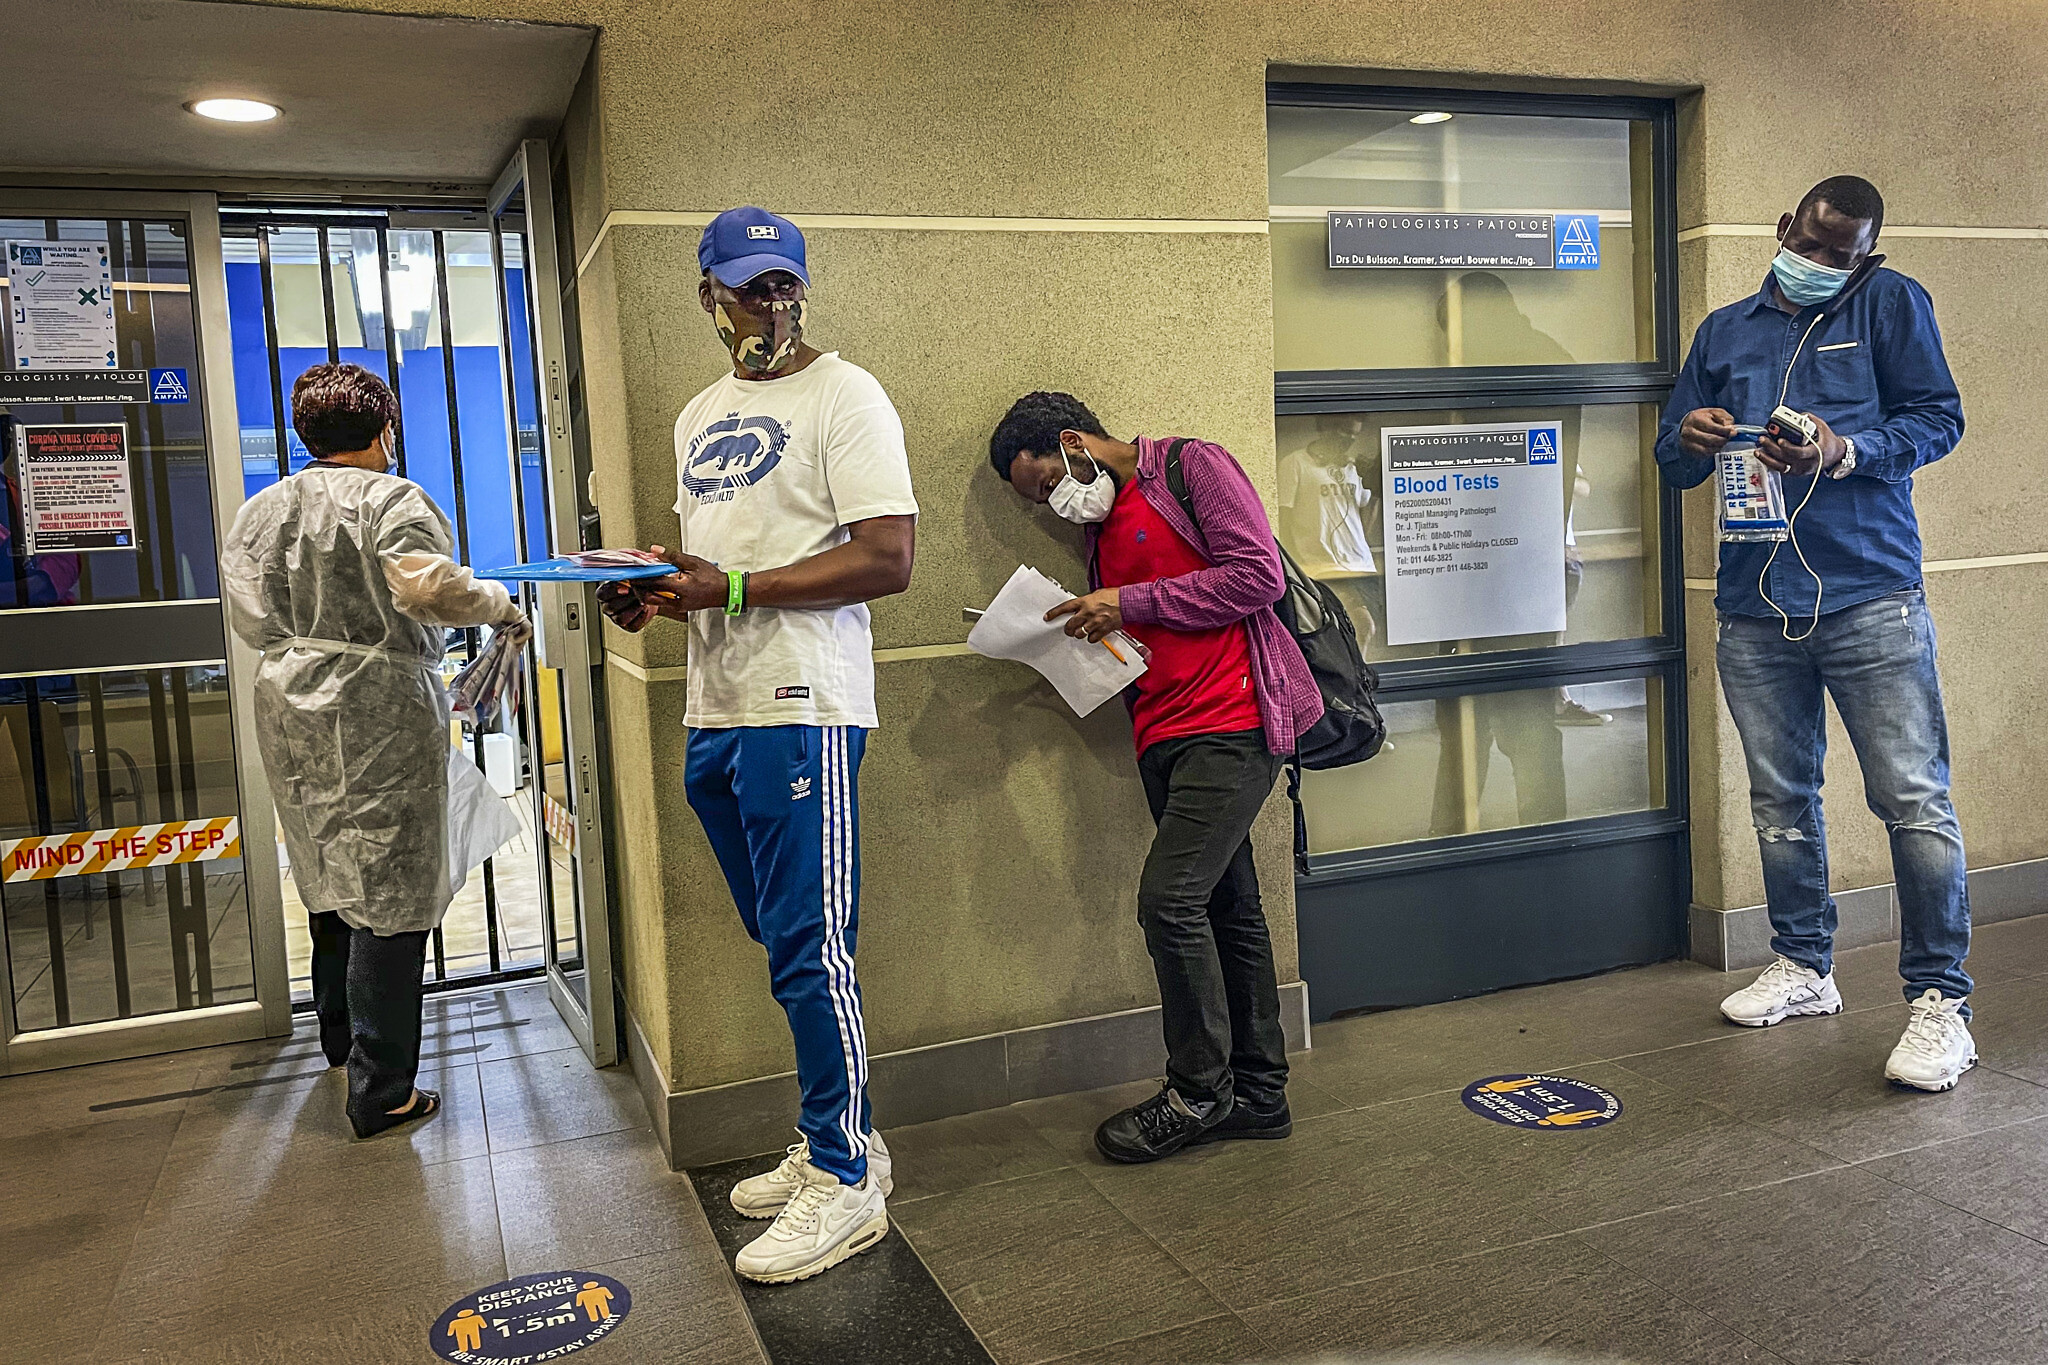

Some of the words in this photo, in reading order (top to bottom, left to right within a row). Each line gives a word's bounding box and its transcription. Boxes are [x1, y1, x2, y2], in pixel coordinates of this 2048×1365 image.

[1334, 217, 1459, 230] PATHOLOGISTS
[1336, 254, 1350, 265] Drs
[1352, 254, 1364, 265] Du
[1366, 254, 1401, 266] Buisson,
[1403, 254, 1438, 266] Kramer,
[1467, 255, 1499, 265] Bouwer
[1558, 255, 1598, 265] AMPATH
[154, 393, 188, 401] AMPATH
[28, 434, 58, 444] CORONA
[60, 433, 81, 444] VIRUS
[1393, 436, 1469, 446] PATHOLOGISTS
[1531, 454, 1556, 462] AMPATH
[1394, 474, 1447, 495] Blood
[1453, 473, 1500, 491] Tests
[1724, 454, 1737, 508] ROUTINE
[1734, 455, 1748, 508] ROETINE
[61, 512, 91, 520] NECESSARY
[92, 511, 99, 519] TO
[100, 511, 123, 519] PREVENT
[1395, 510, 1424, 521] Regional
[1426, 508, 1458, 518] Managing
[1460, 506, 1496, 516] Pathologist
[38, 522, 64, 530] POSSIBLE
[65, 521, 91, 529] TRANSFER
[100, 520, 111, 528] THE
[1396, 534, 1411, 543] Mon
[1396, 544, 1431, 554] Weekends
[1439, 541, 1460, 551] Public
[1461, 539, 1489, 550] Holidays
[1491, 537, 1519, 547] CLOSED
[1397, 556, 1408, 565] Tel:
[1410, 555, 1421, 564] 011
[1397, 565, 1434, 577] Emergency
[1446, 564, 1458, 573] 011
[791, 789, 811, 801] adidas
[15, 844, 84, 871] MIND
[93, 836, 147, 861] THE
[156, 828, 229, 855] STEP.
[1471, 1094, 1501, 1111] YOUR
[1530, 1087, 1575, 1110] 1.5m
[1483, 1092, 1540, 1121] DISTANCE
[1496, 1109, 1525, 1123] KEEP
[477, 1288, 522, 1304] KEEP
[524, 1276, 574, 1292] YOUR
[478, 1283, 578, 1313] DISTANCE
[496, 1311, 576, 1338] 1.5m
[472, 1354, 532, 1365] SMART
[536, 1339, 585, 1361] #STAY
[586, 1312, 622, 1342] APART
